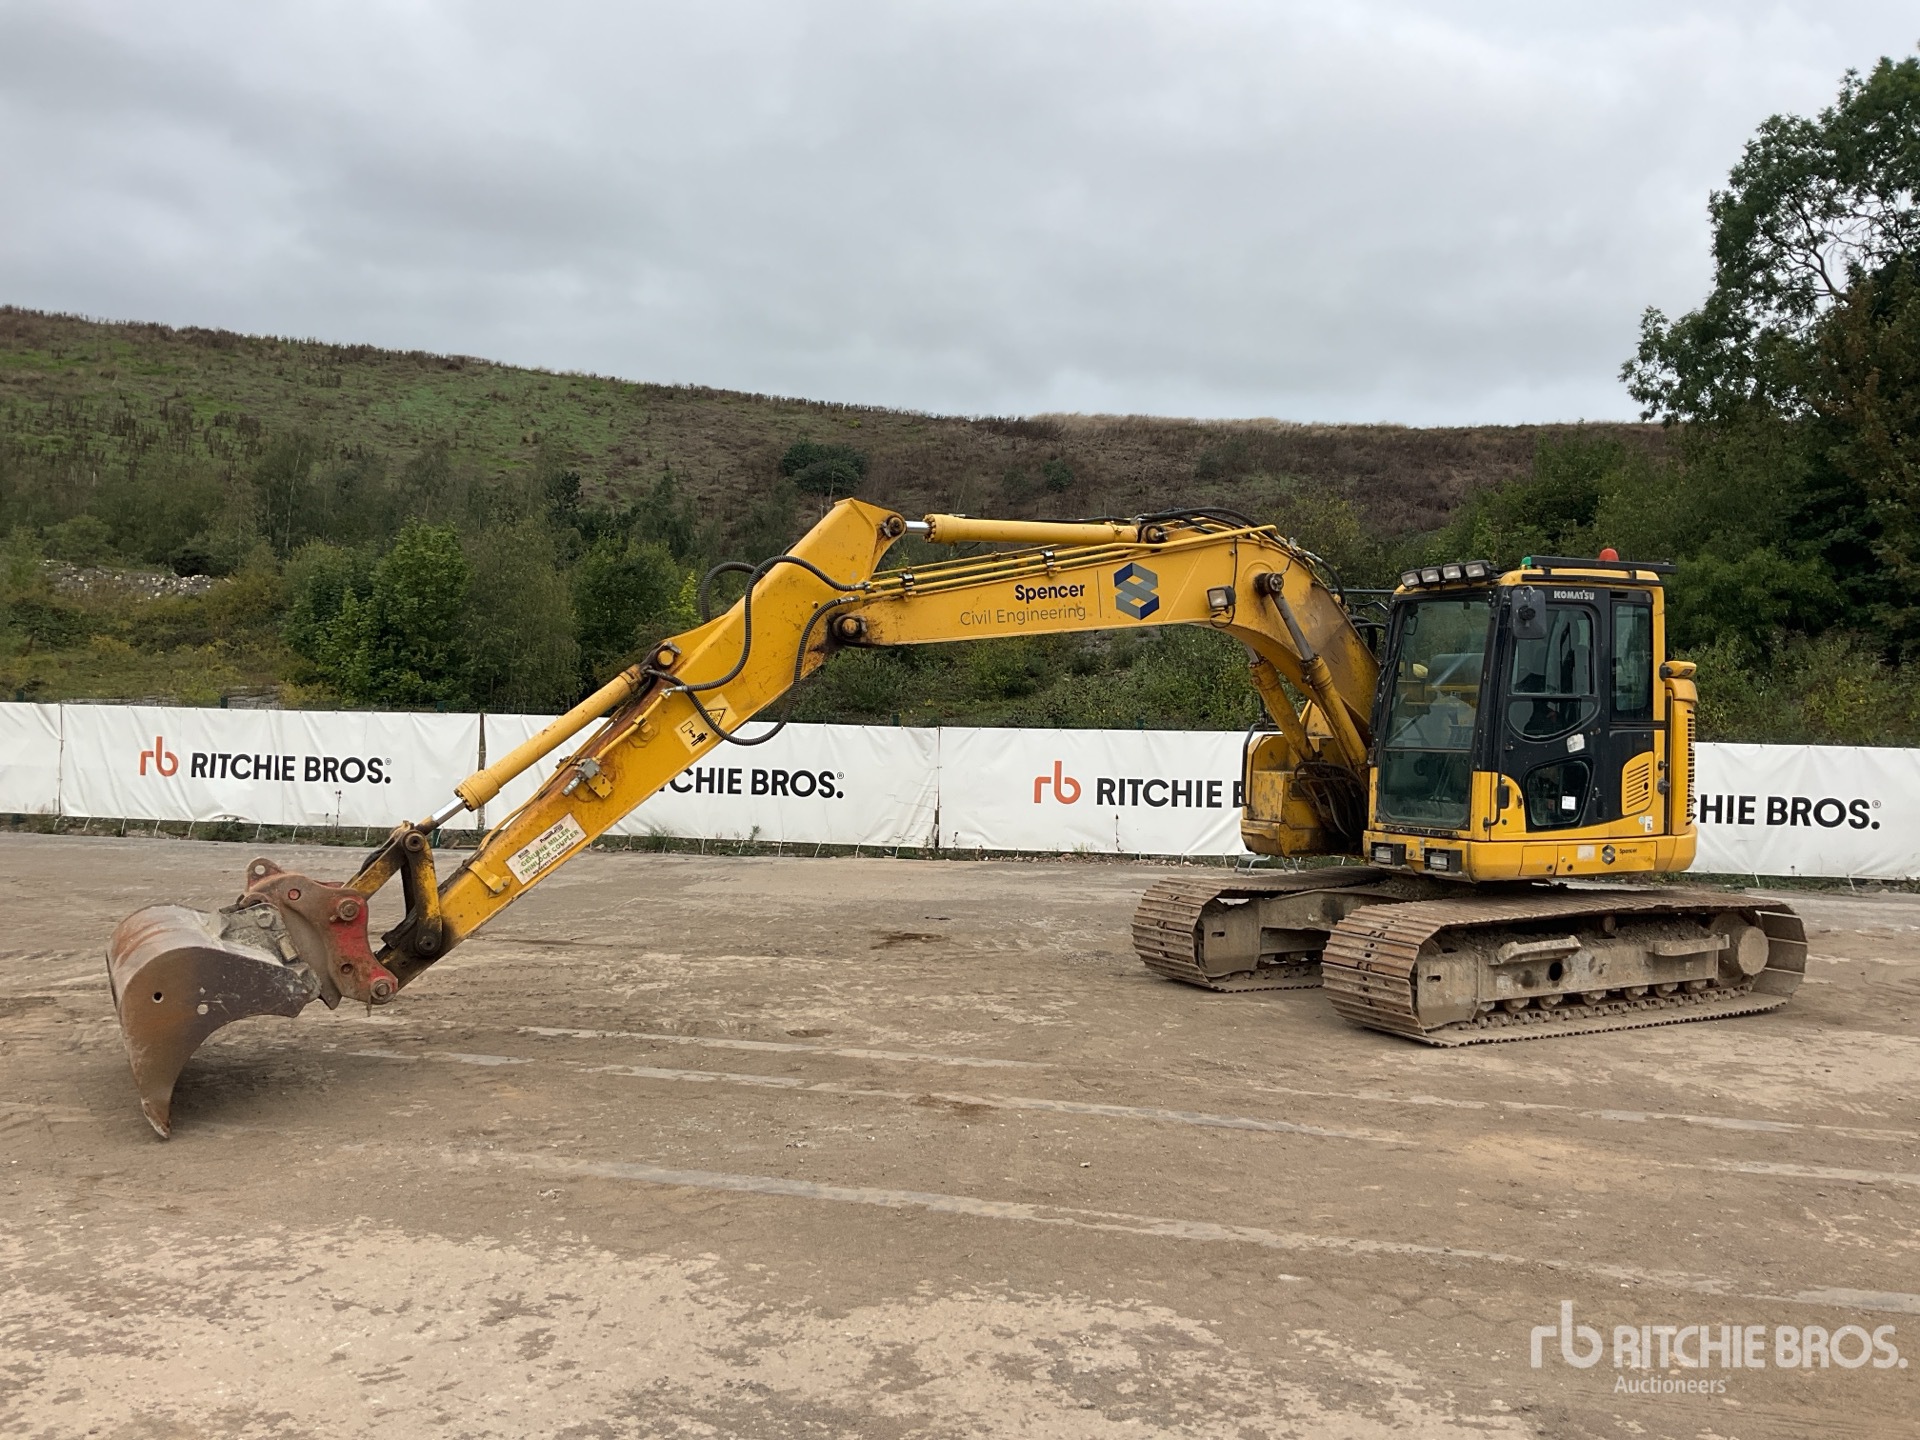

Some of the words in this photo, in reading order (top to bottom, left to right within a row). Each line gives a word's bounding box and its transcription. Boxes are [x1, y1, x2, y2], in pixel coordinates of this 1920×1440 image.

[1014, 583, 1086, 604] Spencer
[1553, 589, 1595, 600] KOMATSU
[959, 610, 991, 626] Civil
[996, 604, 1086, 626] Engineering
[139, 735, 179, 777] rb
[190, 752, 296, 782] RITCHIE
[659, 767, 743, 795] CHIE
[1033, 760, 1082, 805] rb
[1096, 777, 1223, 809] RITCHIE
[519, 851, 552, 877] TWINLOCK
[552, 829, 580, 852] COUPLER
[520, 843, 550, 867] GENUINE
[548, 827, 571, 847] MILLER
